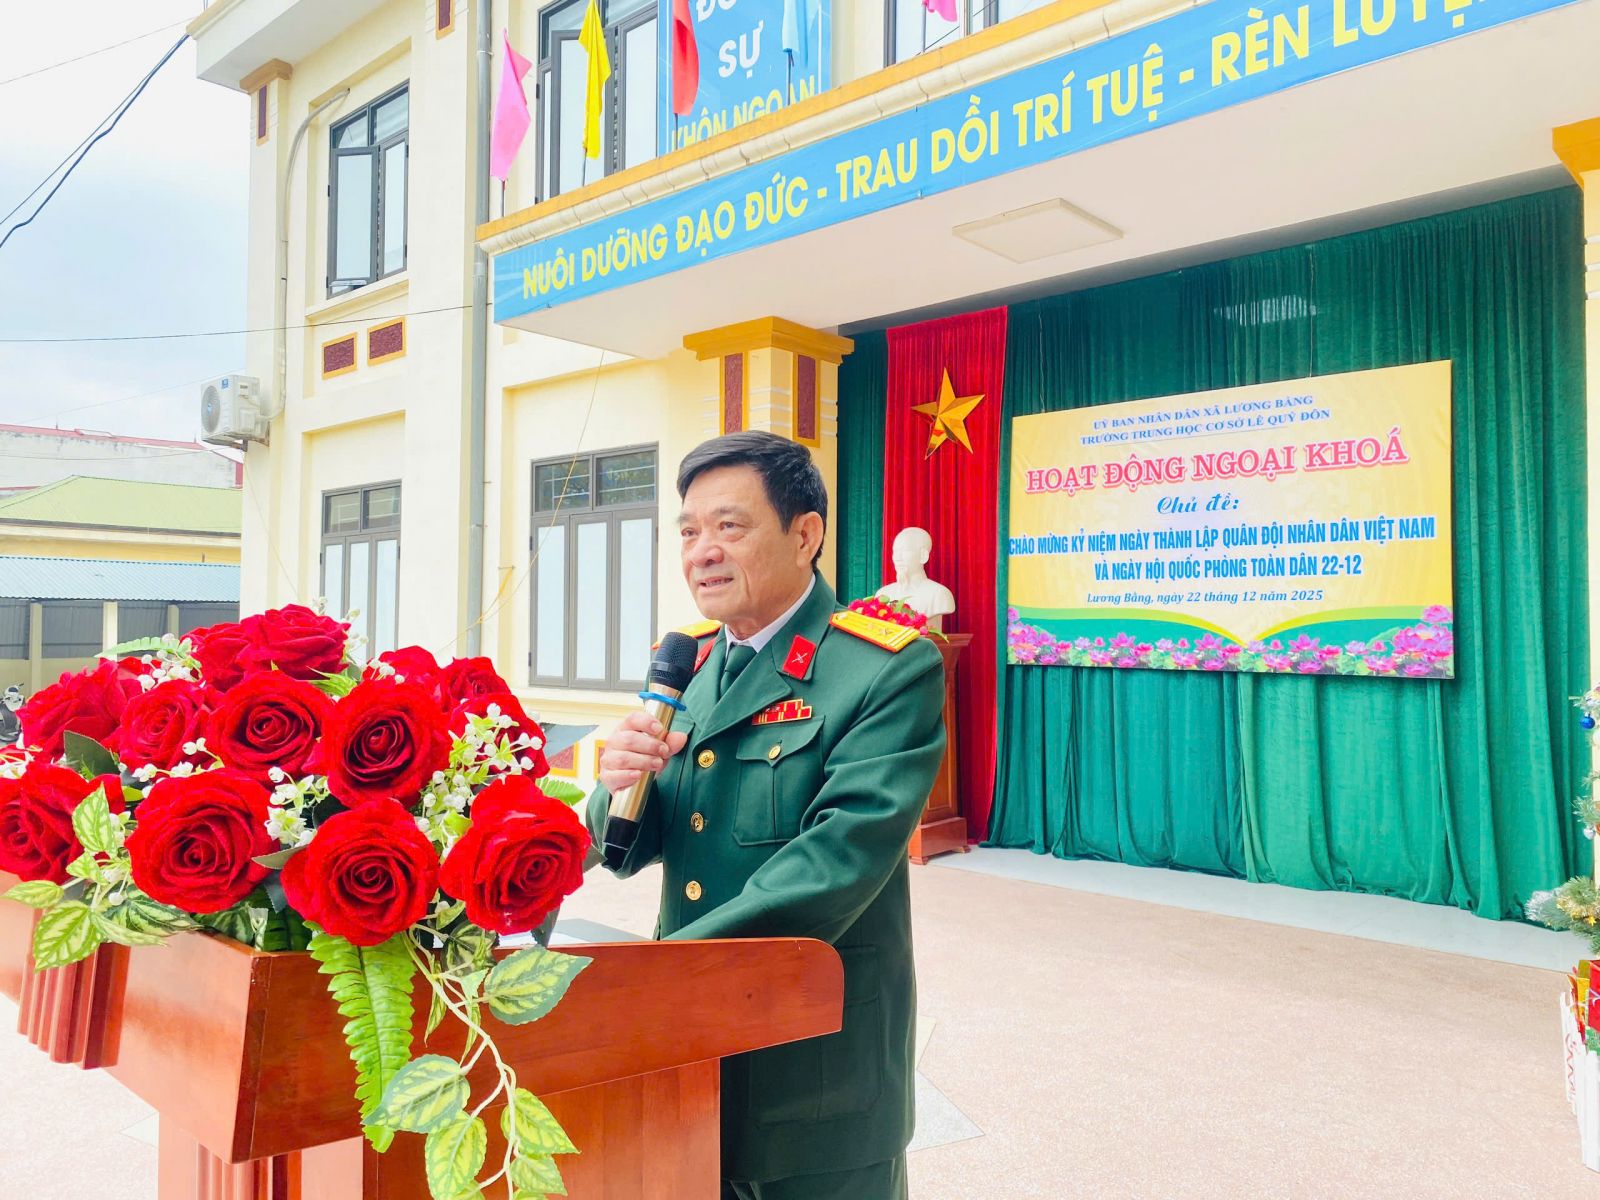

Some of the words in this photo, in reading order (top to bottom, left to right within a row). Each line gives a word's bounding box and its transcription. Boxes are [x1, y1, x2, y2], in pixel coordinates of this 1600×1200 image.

[718, 20, 764, 79] SỰ
[523, 248, 575, 299] NUÔI
[582, 224, 669, 282] DƯỠNG
[676, 200, 736, 257] ĐẠO
[744, 172, 808, 231] ĐỨC
[836, 138, 918, 202] TRAU
[931, 94, 999, 174] DỒI
[1013, 70, 1076, 147] TRÍ
[1087, 42, 1164, 124] TUỆ
[1211, 6, 1309, 87] RÈN
[1080, 431, 1129, 446] TRƯỜNG
[1131, 426, 1173, 440] TRUNG
[1175, 422, 1203, 436] HỌC
[1205, 421, 1224, 432] CƠ
[1226, 417, 1244, 429] SỞ
[1247, 414, 1264, 427] LÊ
[1267, 411, 1296, 426] QUÝ
[1300, 408, 1331, 421] ĐÔN
[1112, 417, 1135, 428] BAN
[1138, 411, 1171, 424] NHÂN
[1174, 408, 1200, 420] DÂN
[1203, 404, 1221, 417] XÃ
[1224, 400, 1271, 415] LƯƠNG
[1026, 464, 1097, 494] HOẠT
[1104, 453, 1186, 490] ĐỘNG
[1192, 445, 1296, 480] NGOẠI
[1304, 426, 1408, 469] KHOÁ
[1157, 495, 1198, 514] Chủ
[1206, 492, 1240, 512] đề:
[1009, 534, 1035, 555] CHÀO
[1037, 532, 1069, 554] MỪNG
[1071, 527, 1085, 553] KỶ
[1088, 531, 1117, 555] NIỆM
[1119, 529, 1150, 551] NGÀY
[1153, 527, 1192, 549] THÀNH
[1196, 525, 1219, 551] LẬP
[1223, 523, 1258, 549] QUÂN
[1261, 522, 1283, 549] ĐỘI
[1288, 519, 1326, 544] NHÂN
[1330, 517, 1360, 542] DÂN
[1363, 515, 1395, 544] VIỆT
[1399, 516, 1435, 539] NAM
[1094, 560, 1109, 580] VÀ
[1112, 558, 1142, 580] NGÀY
[1145, 557, 1165, 583] HỘI
[1168, 554, 1200, 581] QUỐC
[1204, 555, 1247, 578] PHÒNG
[1251, 553, 1286, 577] TOÀN
[1289, 552, 1317, 576] DÂN
[1321, 554, 1362, 575] 22-12
[1087, 592, 1121, 605] Lương
[1156, 592, 1184, 605] ngày
[1187, 591, 1201, 602] 22
[1204, 591, 1239, 604] tháng
[1242, 591, 1256, 602] 12
[1259, 591, 1287, 601] năm
[1290, 589, 1324, 601] 2025
